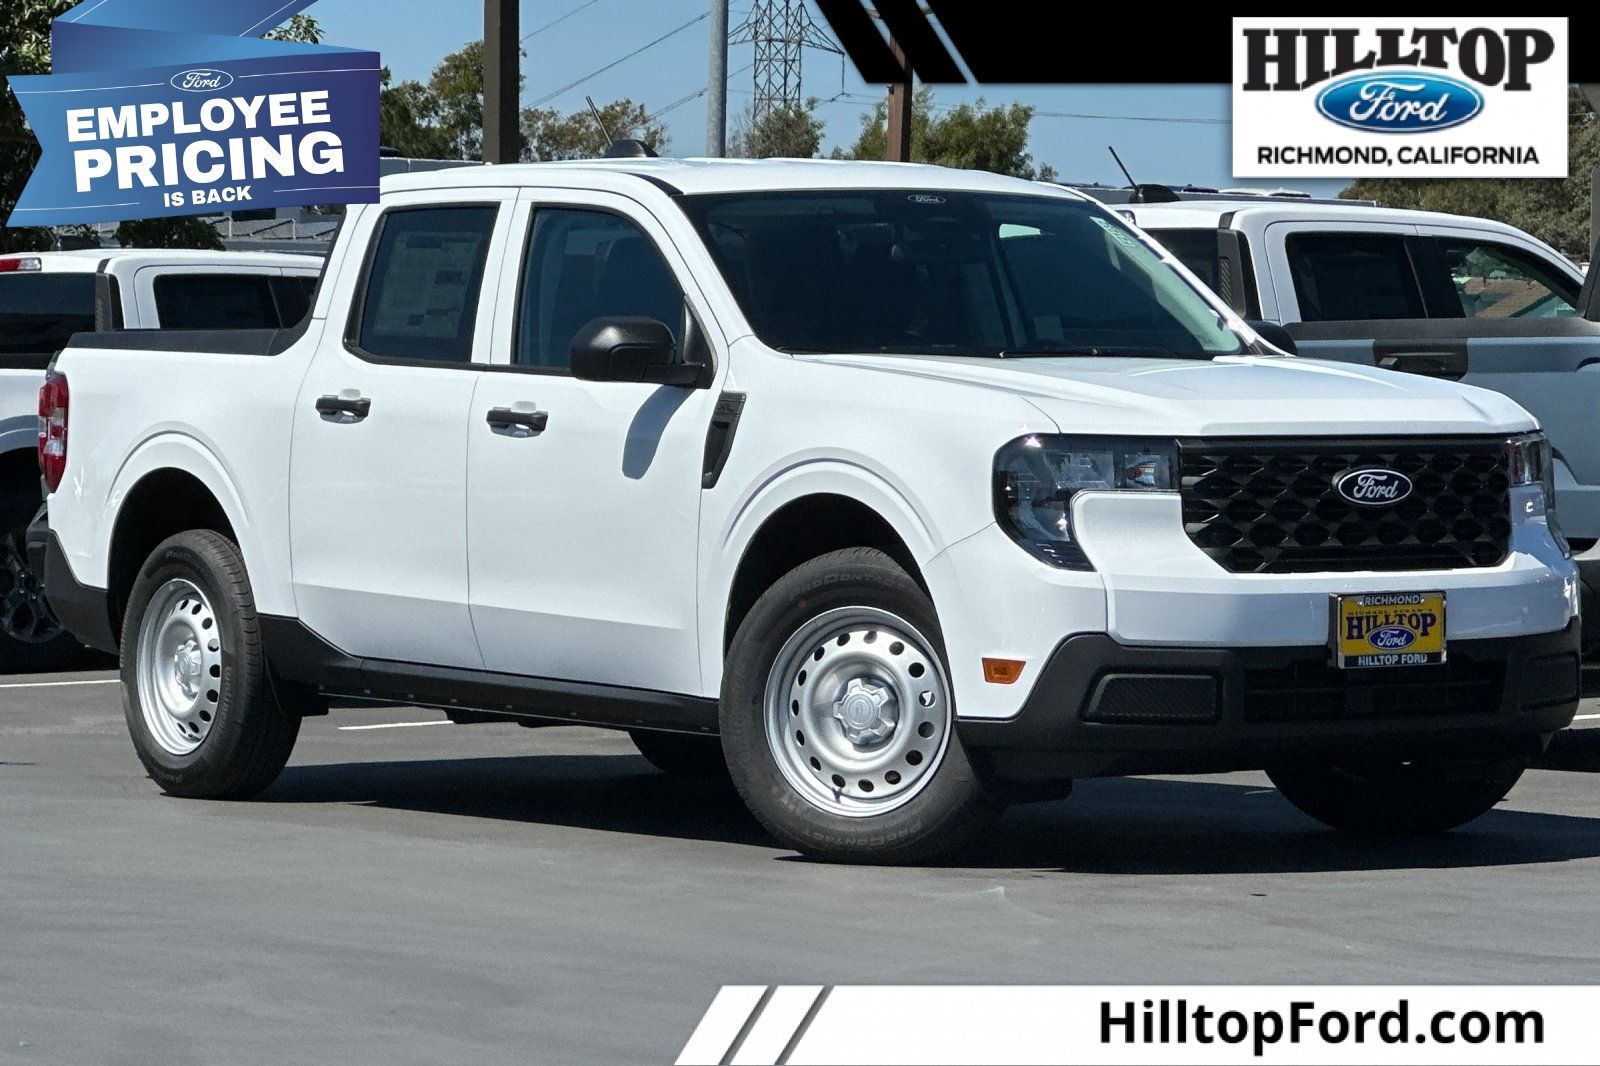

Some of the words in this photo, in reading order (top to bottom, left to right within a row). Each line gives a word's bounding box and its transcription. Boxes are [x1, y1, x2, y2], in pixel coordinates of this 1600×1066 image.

[1353, 474, 1399, 498] Ford
[1364, 595, 1420, 606] RICHMOND
[1346, 613, 1437, 640] HILLTOP
[1377, 629, 1407, 646] Ford
[1358, 654, 1399, 666] HILLTOP
[1401, 653, 1428, 664] FORD
